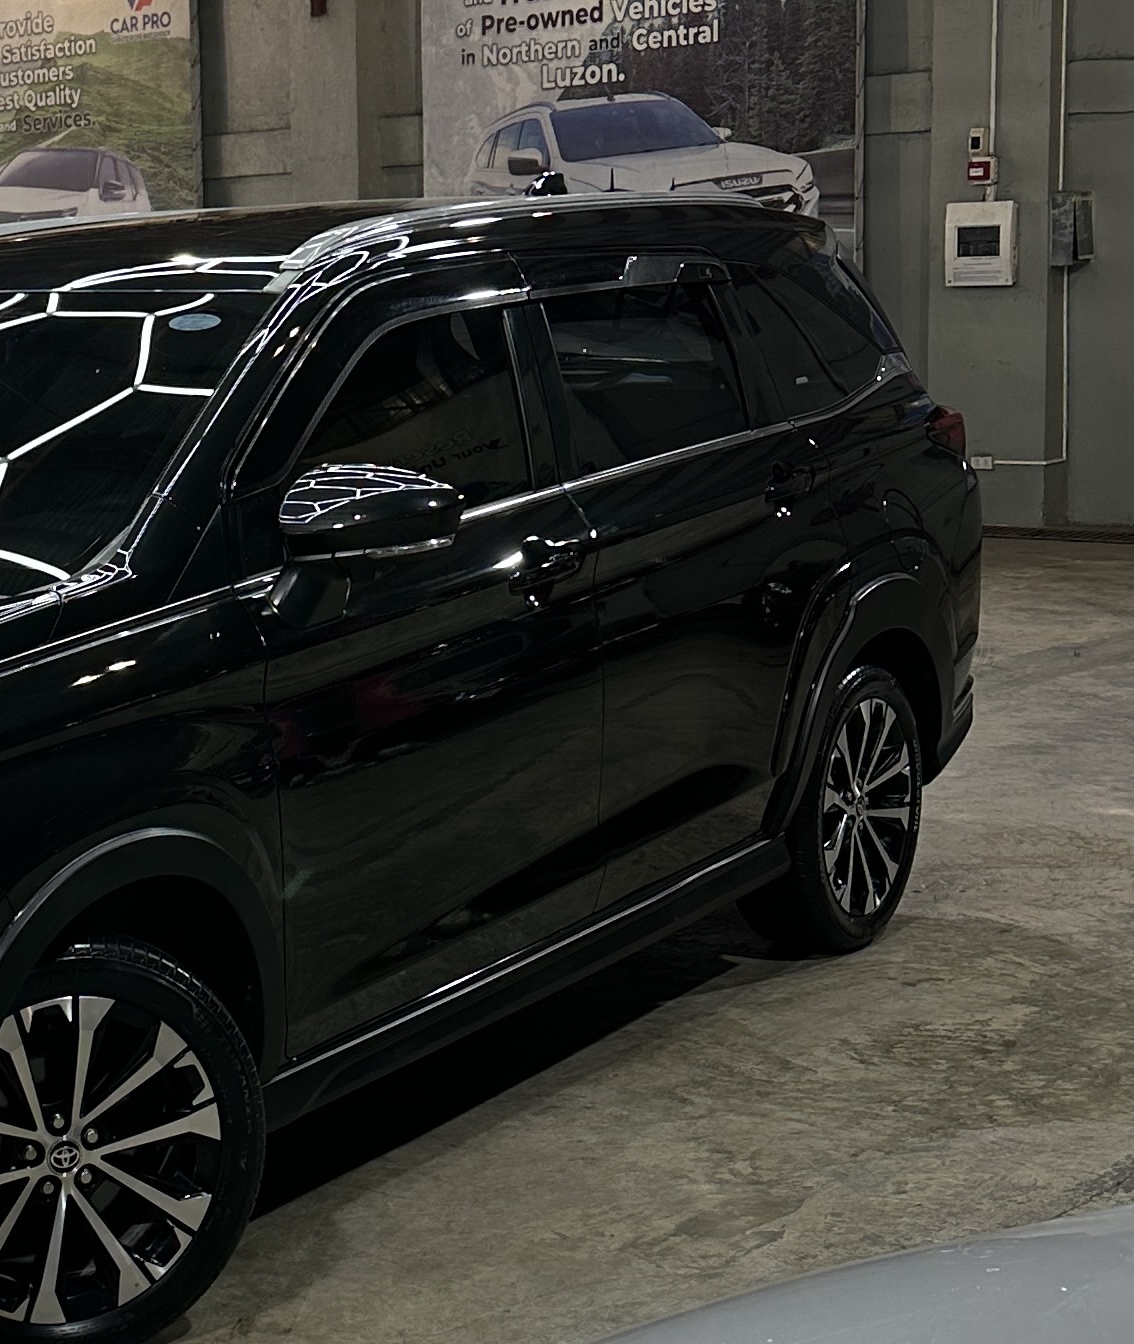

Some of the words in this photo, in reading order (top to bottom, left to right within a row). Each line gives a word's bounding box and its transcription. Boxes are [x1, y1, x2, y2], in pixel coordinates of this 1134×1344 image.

[110, 15, 139, 34] CAR
[143, 11, 171, 31] PRO
[456, 18, 474, 38] of
[481, 1, 604, 37] Pre-owned
[1, 36, 96, 65] Satisfaction
[461, 48, 476, 65] in
[481, 37, 581, 67] Northern
[588, 32, 621, 53] and
[631, 20, 719, 52] Central
[540, 60, 626, 90] Luzon.
[24, 85, 81, 110] Quality
[22, 109, 97, 134] Services.
